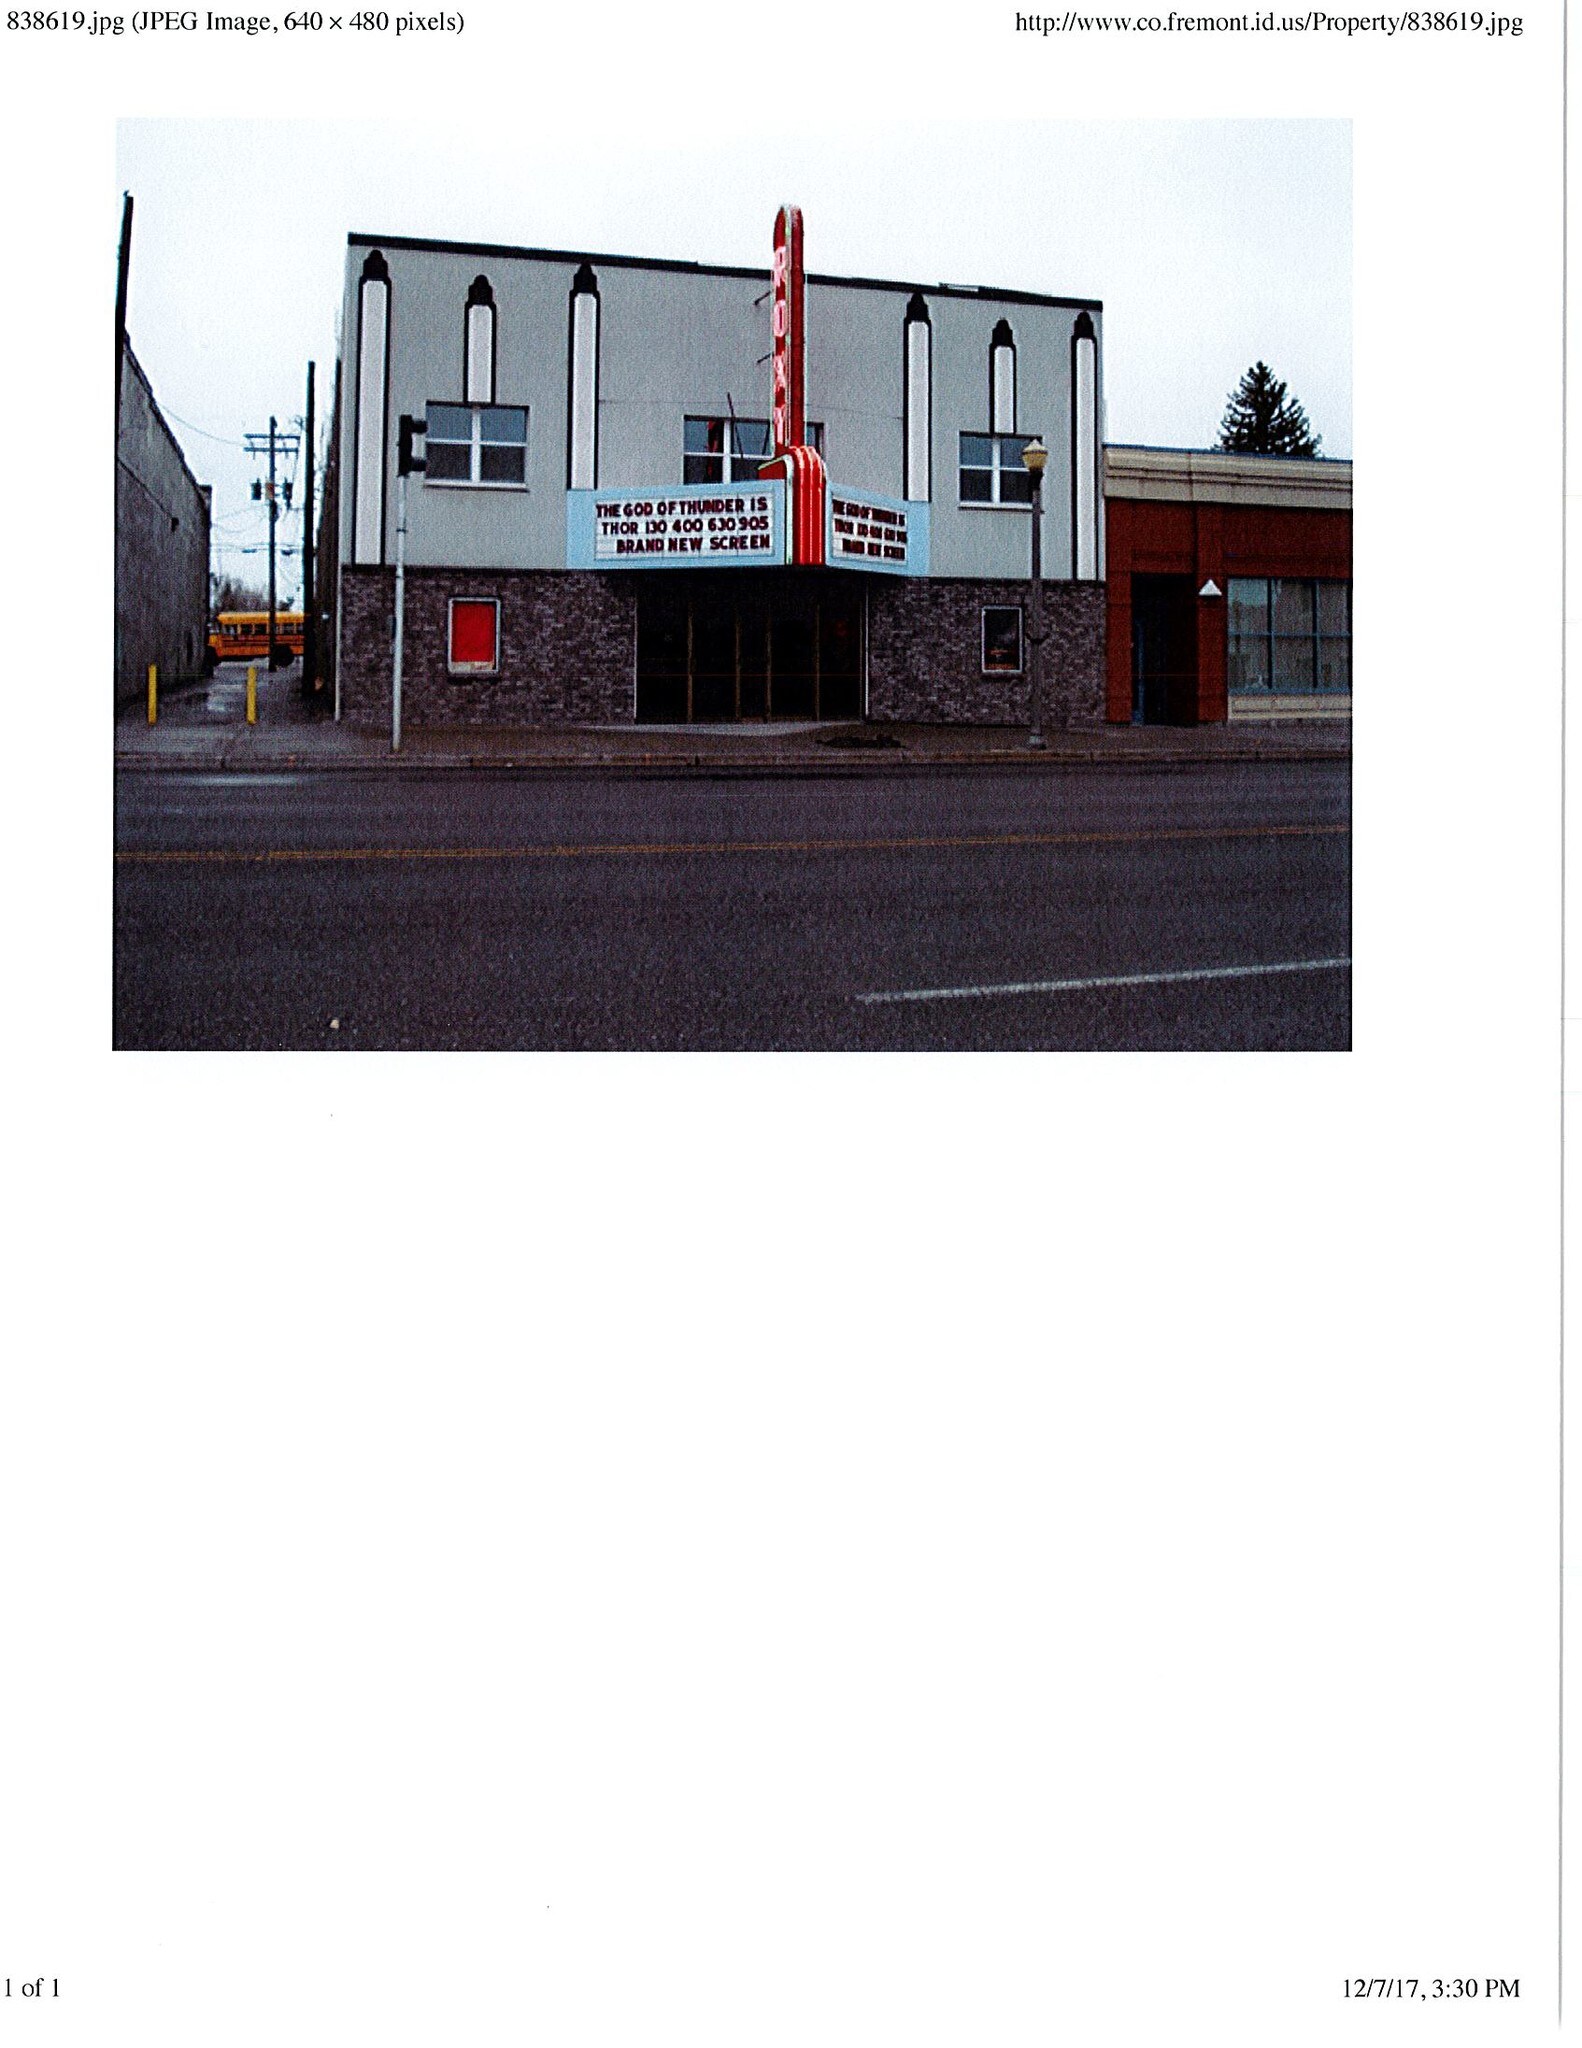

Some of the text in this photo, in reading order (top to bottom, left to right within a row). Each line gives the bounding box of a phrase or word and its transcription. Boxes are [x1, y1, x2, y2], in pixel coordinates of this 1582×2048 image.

[773, 246, 788, 446] ROXY
[596, 497, 768, 518] THE GOD OF THUNDER IS
[602, 516, 769, 535] THOR 130 400 630 905
[616, 535, 770, 554] BRAND NEW SCREEN
